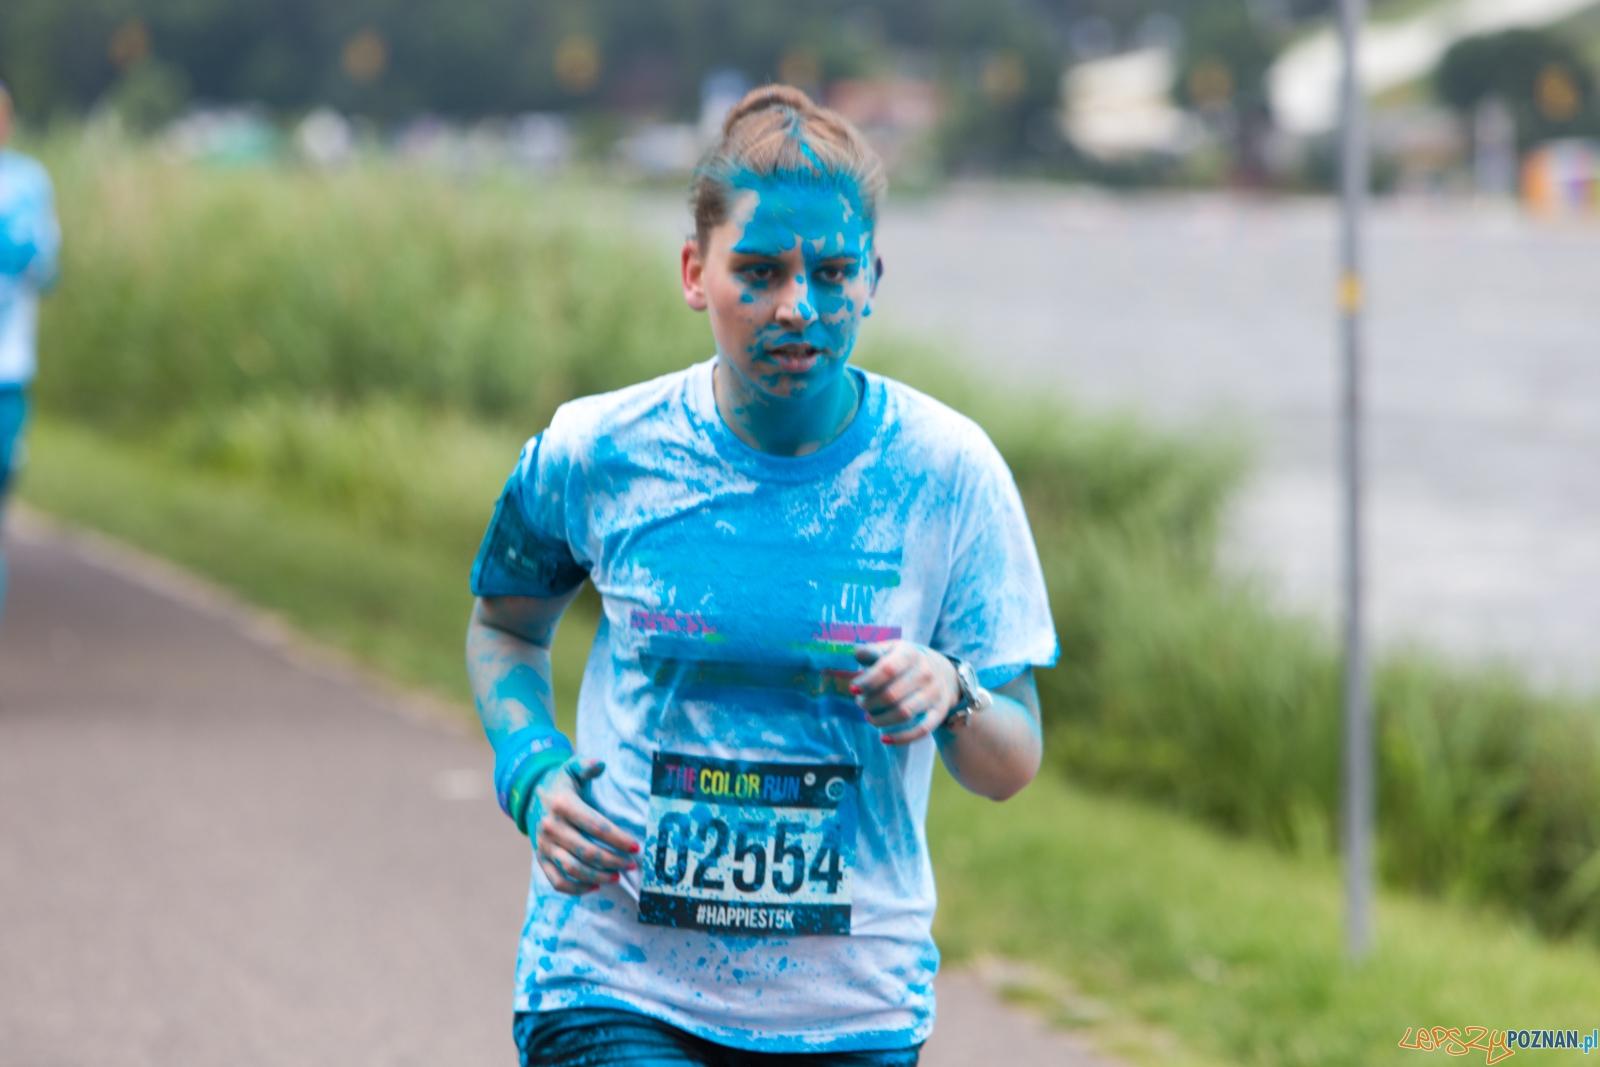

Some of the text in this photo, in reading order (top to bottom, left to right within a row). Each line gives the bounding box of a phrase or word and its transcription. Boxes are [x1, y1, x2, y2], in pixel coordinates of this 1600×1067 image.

[665, 763, 800, 801] THE COLOR RUN
[653, 811, 844, 894] 02554
[696, 904, 795, 928] #HAPPIEST5K
